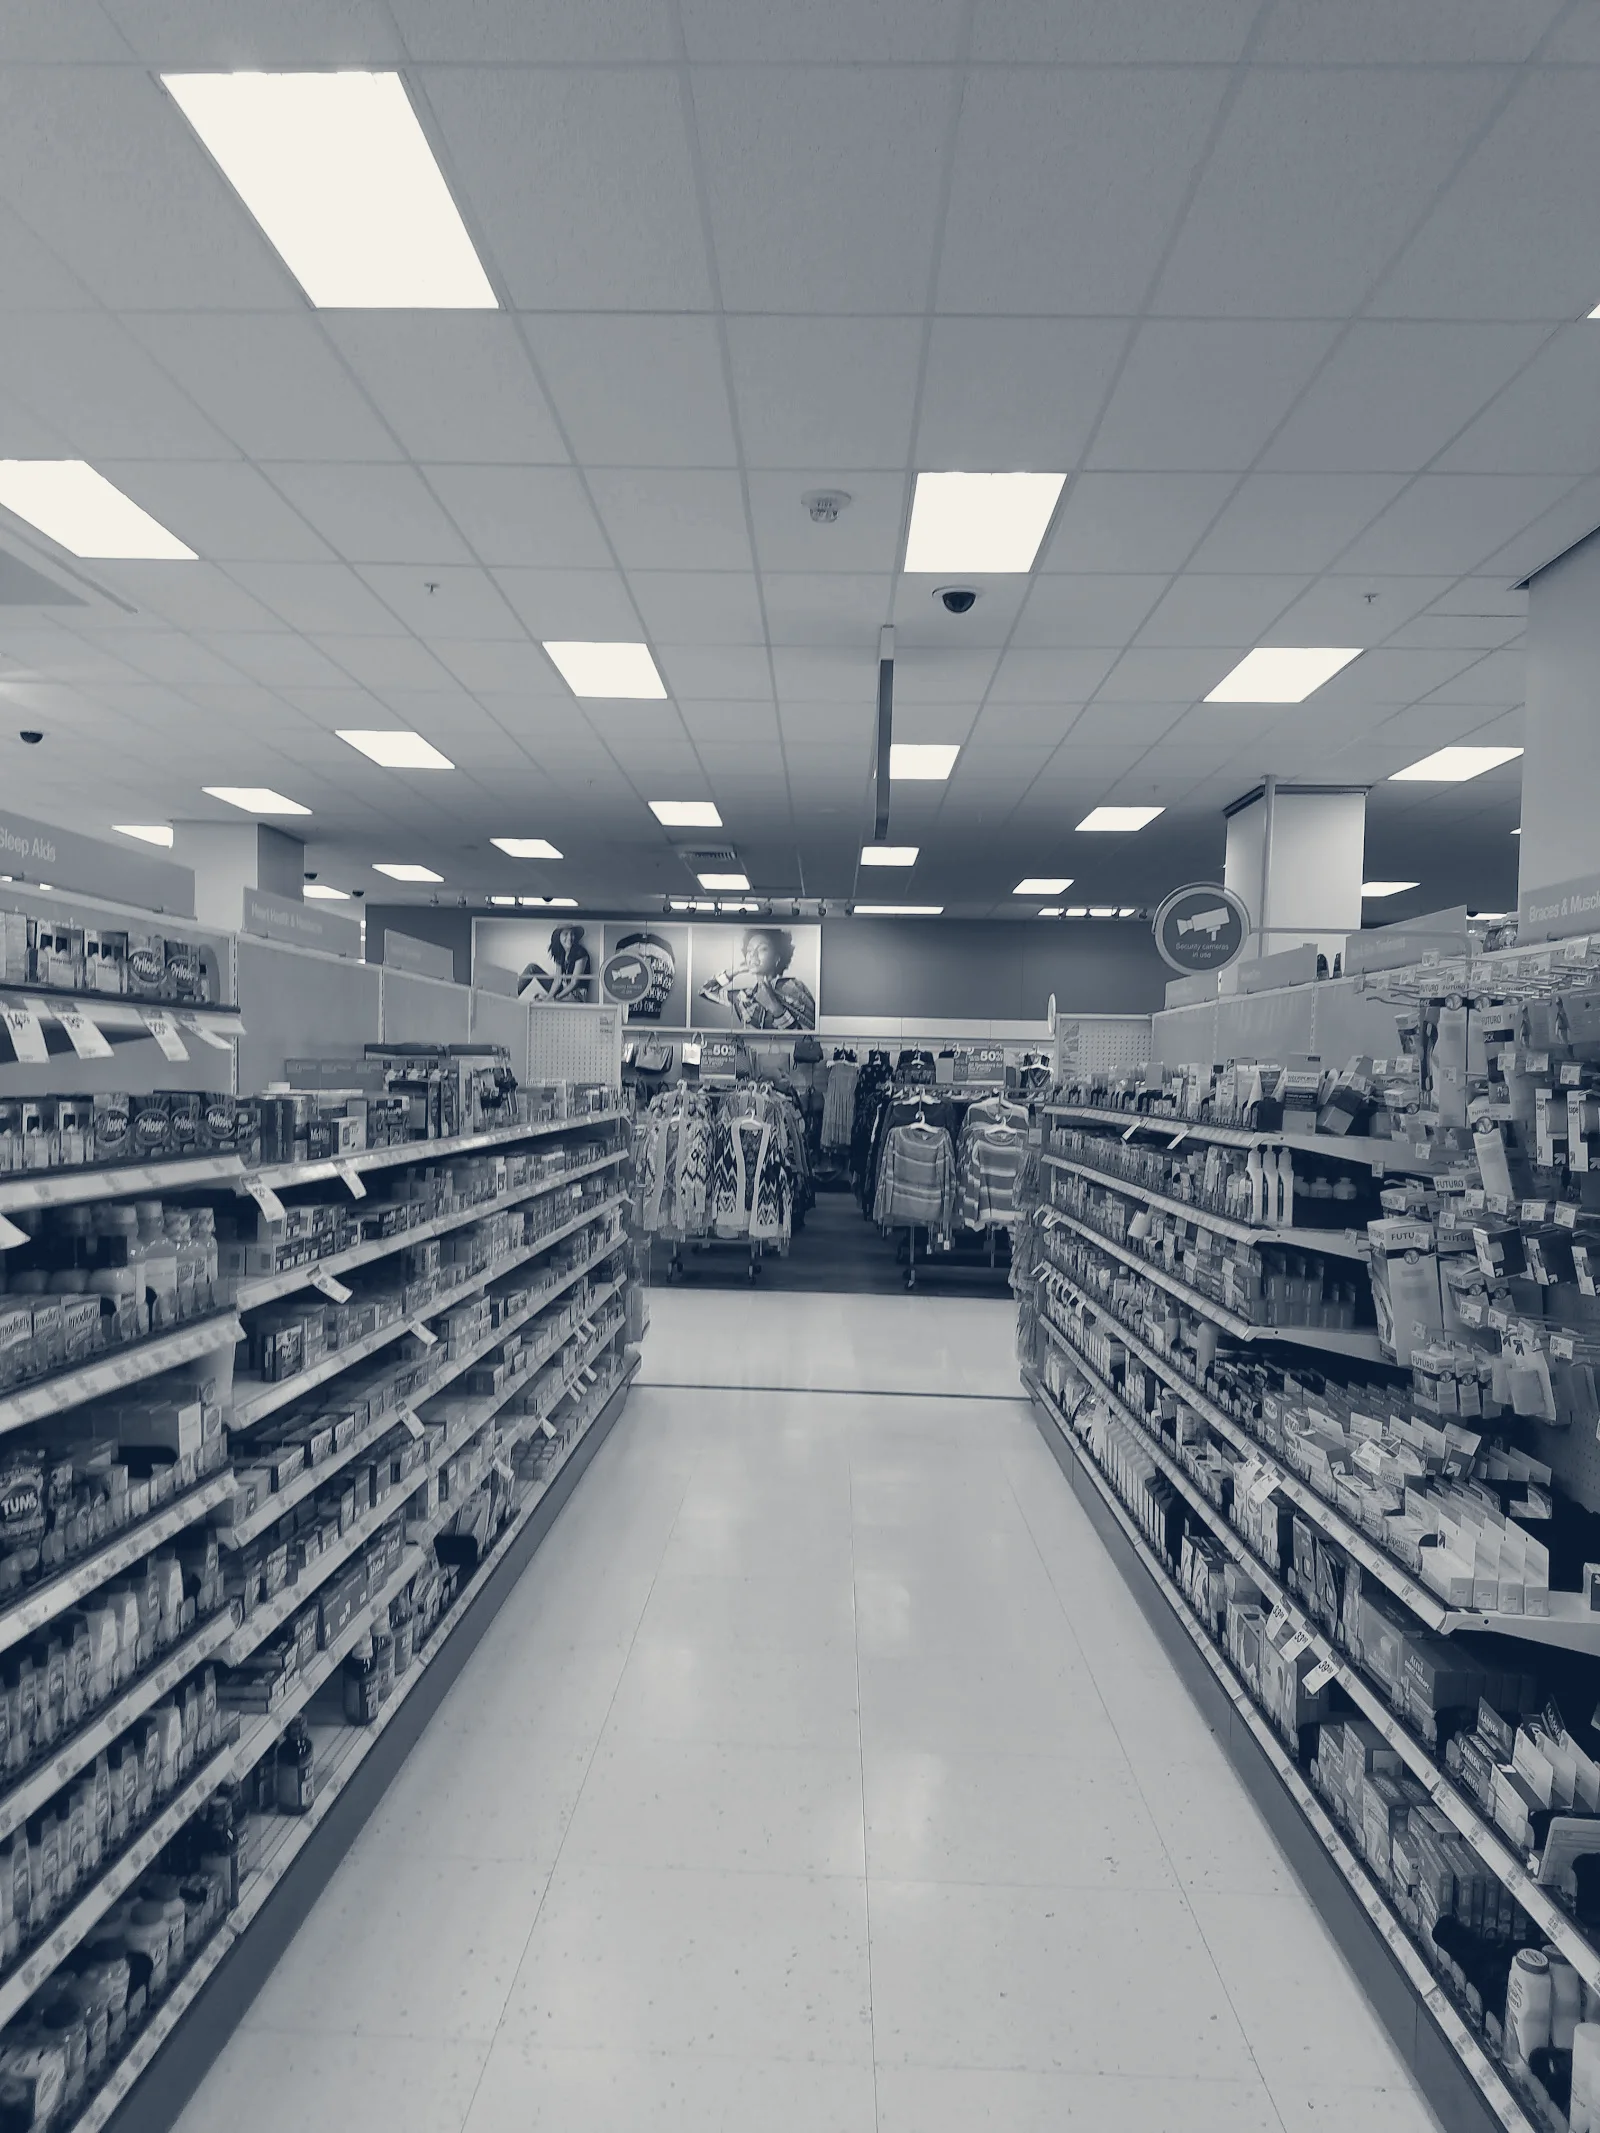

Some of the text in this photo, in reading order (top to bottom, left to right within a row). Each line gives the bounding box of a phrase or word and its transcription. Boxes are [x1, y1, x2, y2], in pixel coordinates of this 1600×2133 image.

[0, 827, 29, 858] Sleep
[1529, 889, 1600, 922] Braces & Muscl
[1175, 942, 1229, 952] Security cameras
[1568, 1106, 1579, 1115] tape
[1436, 1179, 1464, 1189] FUTURO
[1391, 1231, 1415, 1241] FUTU
[0, 1314, 30, 1336] modium
[1412, 1356, 1435, 1370] FUTURO
[0, 1491, 38, 1516] TUMS
